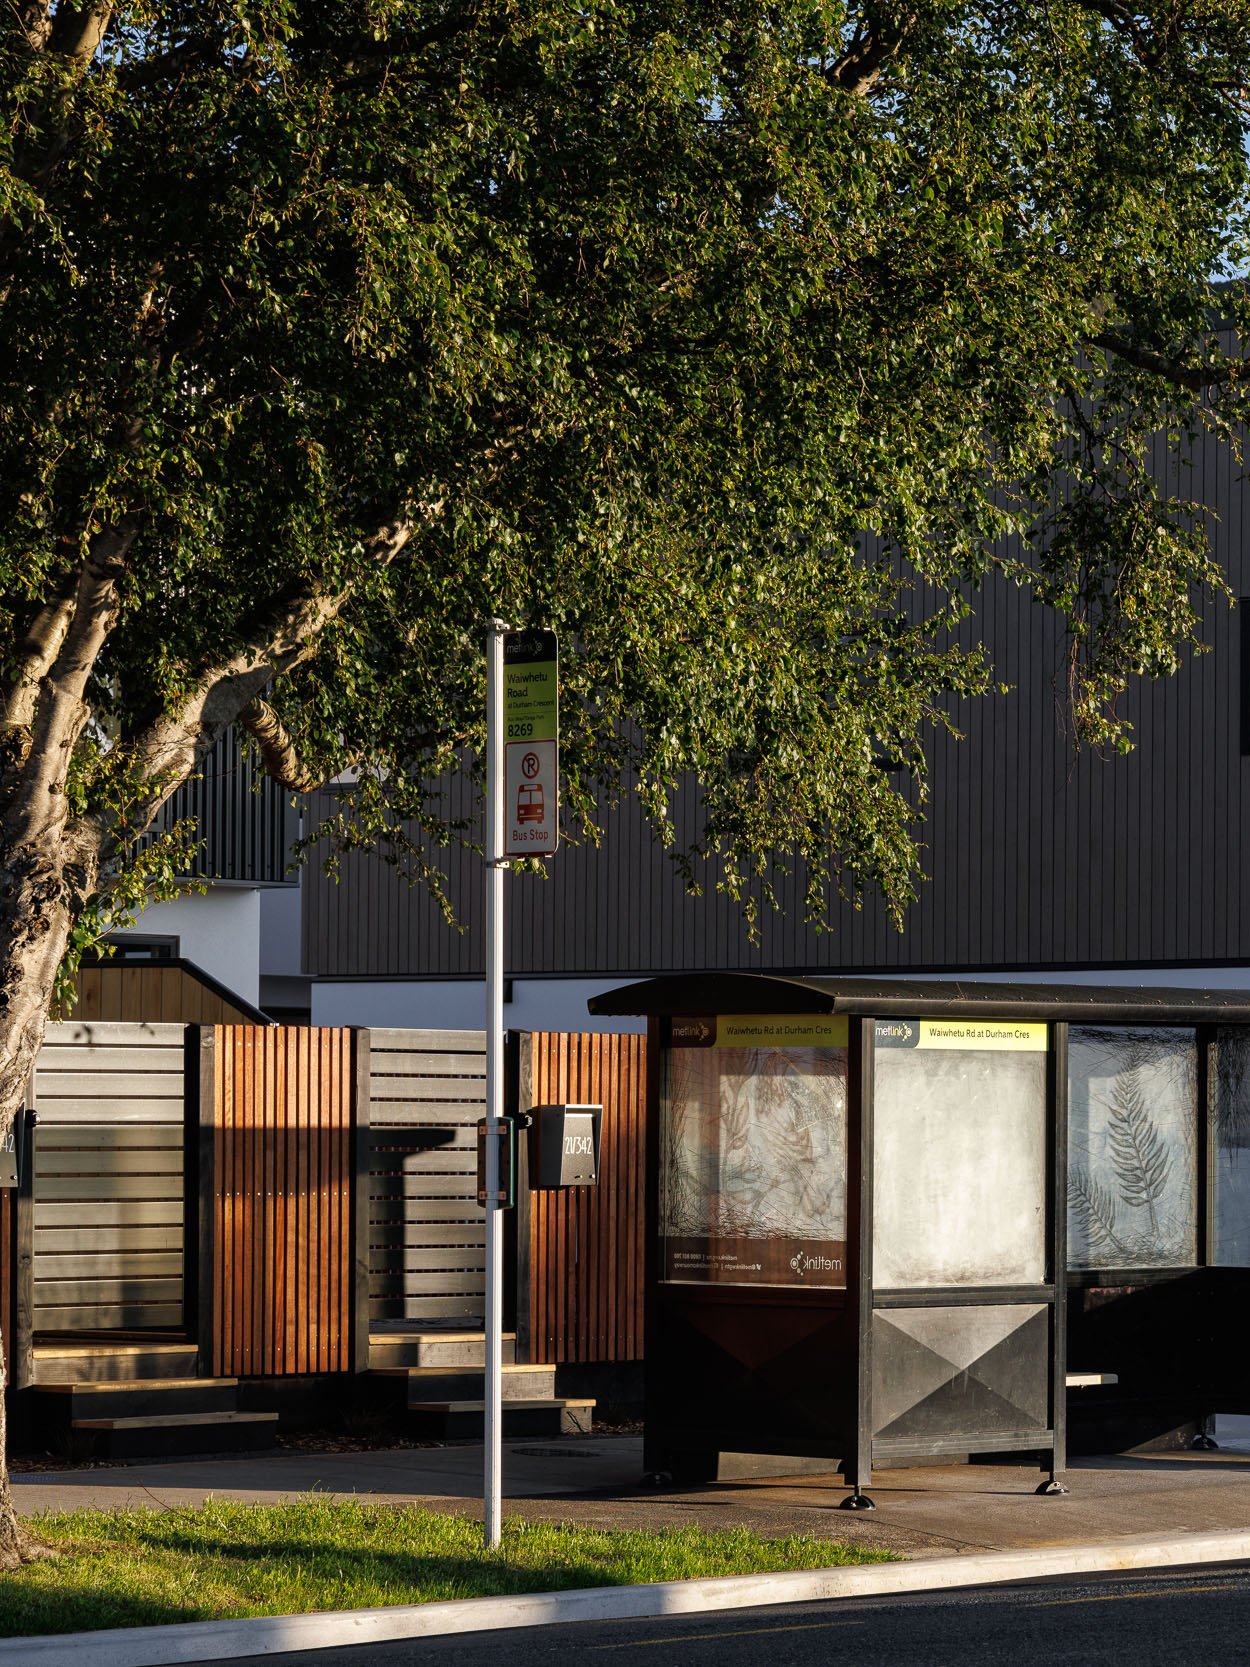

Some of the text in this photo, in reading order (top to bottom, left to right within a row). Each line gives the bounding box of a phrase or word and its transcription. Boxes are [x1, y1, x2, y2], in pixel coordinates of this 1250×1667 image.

[507, 672, 548, 684] Waiwhetu
[507, 687, 528, 698] Road
[507, 723, 533, 738] 8269
[512, 828, 549, 842] Bus Stop
[672, 1025, 700, 1037] metlink
[726, 1025, 832, 1036] Waiwhetu Rd at Durham Cres
[875, 1025, 904, 1037] metlink
[929, 1028, 1030, 1039] Waiwhetu Rd at Durham Cres
[564, 1136, 592, 1155] 21/342
